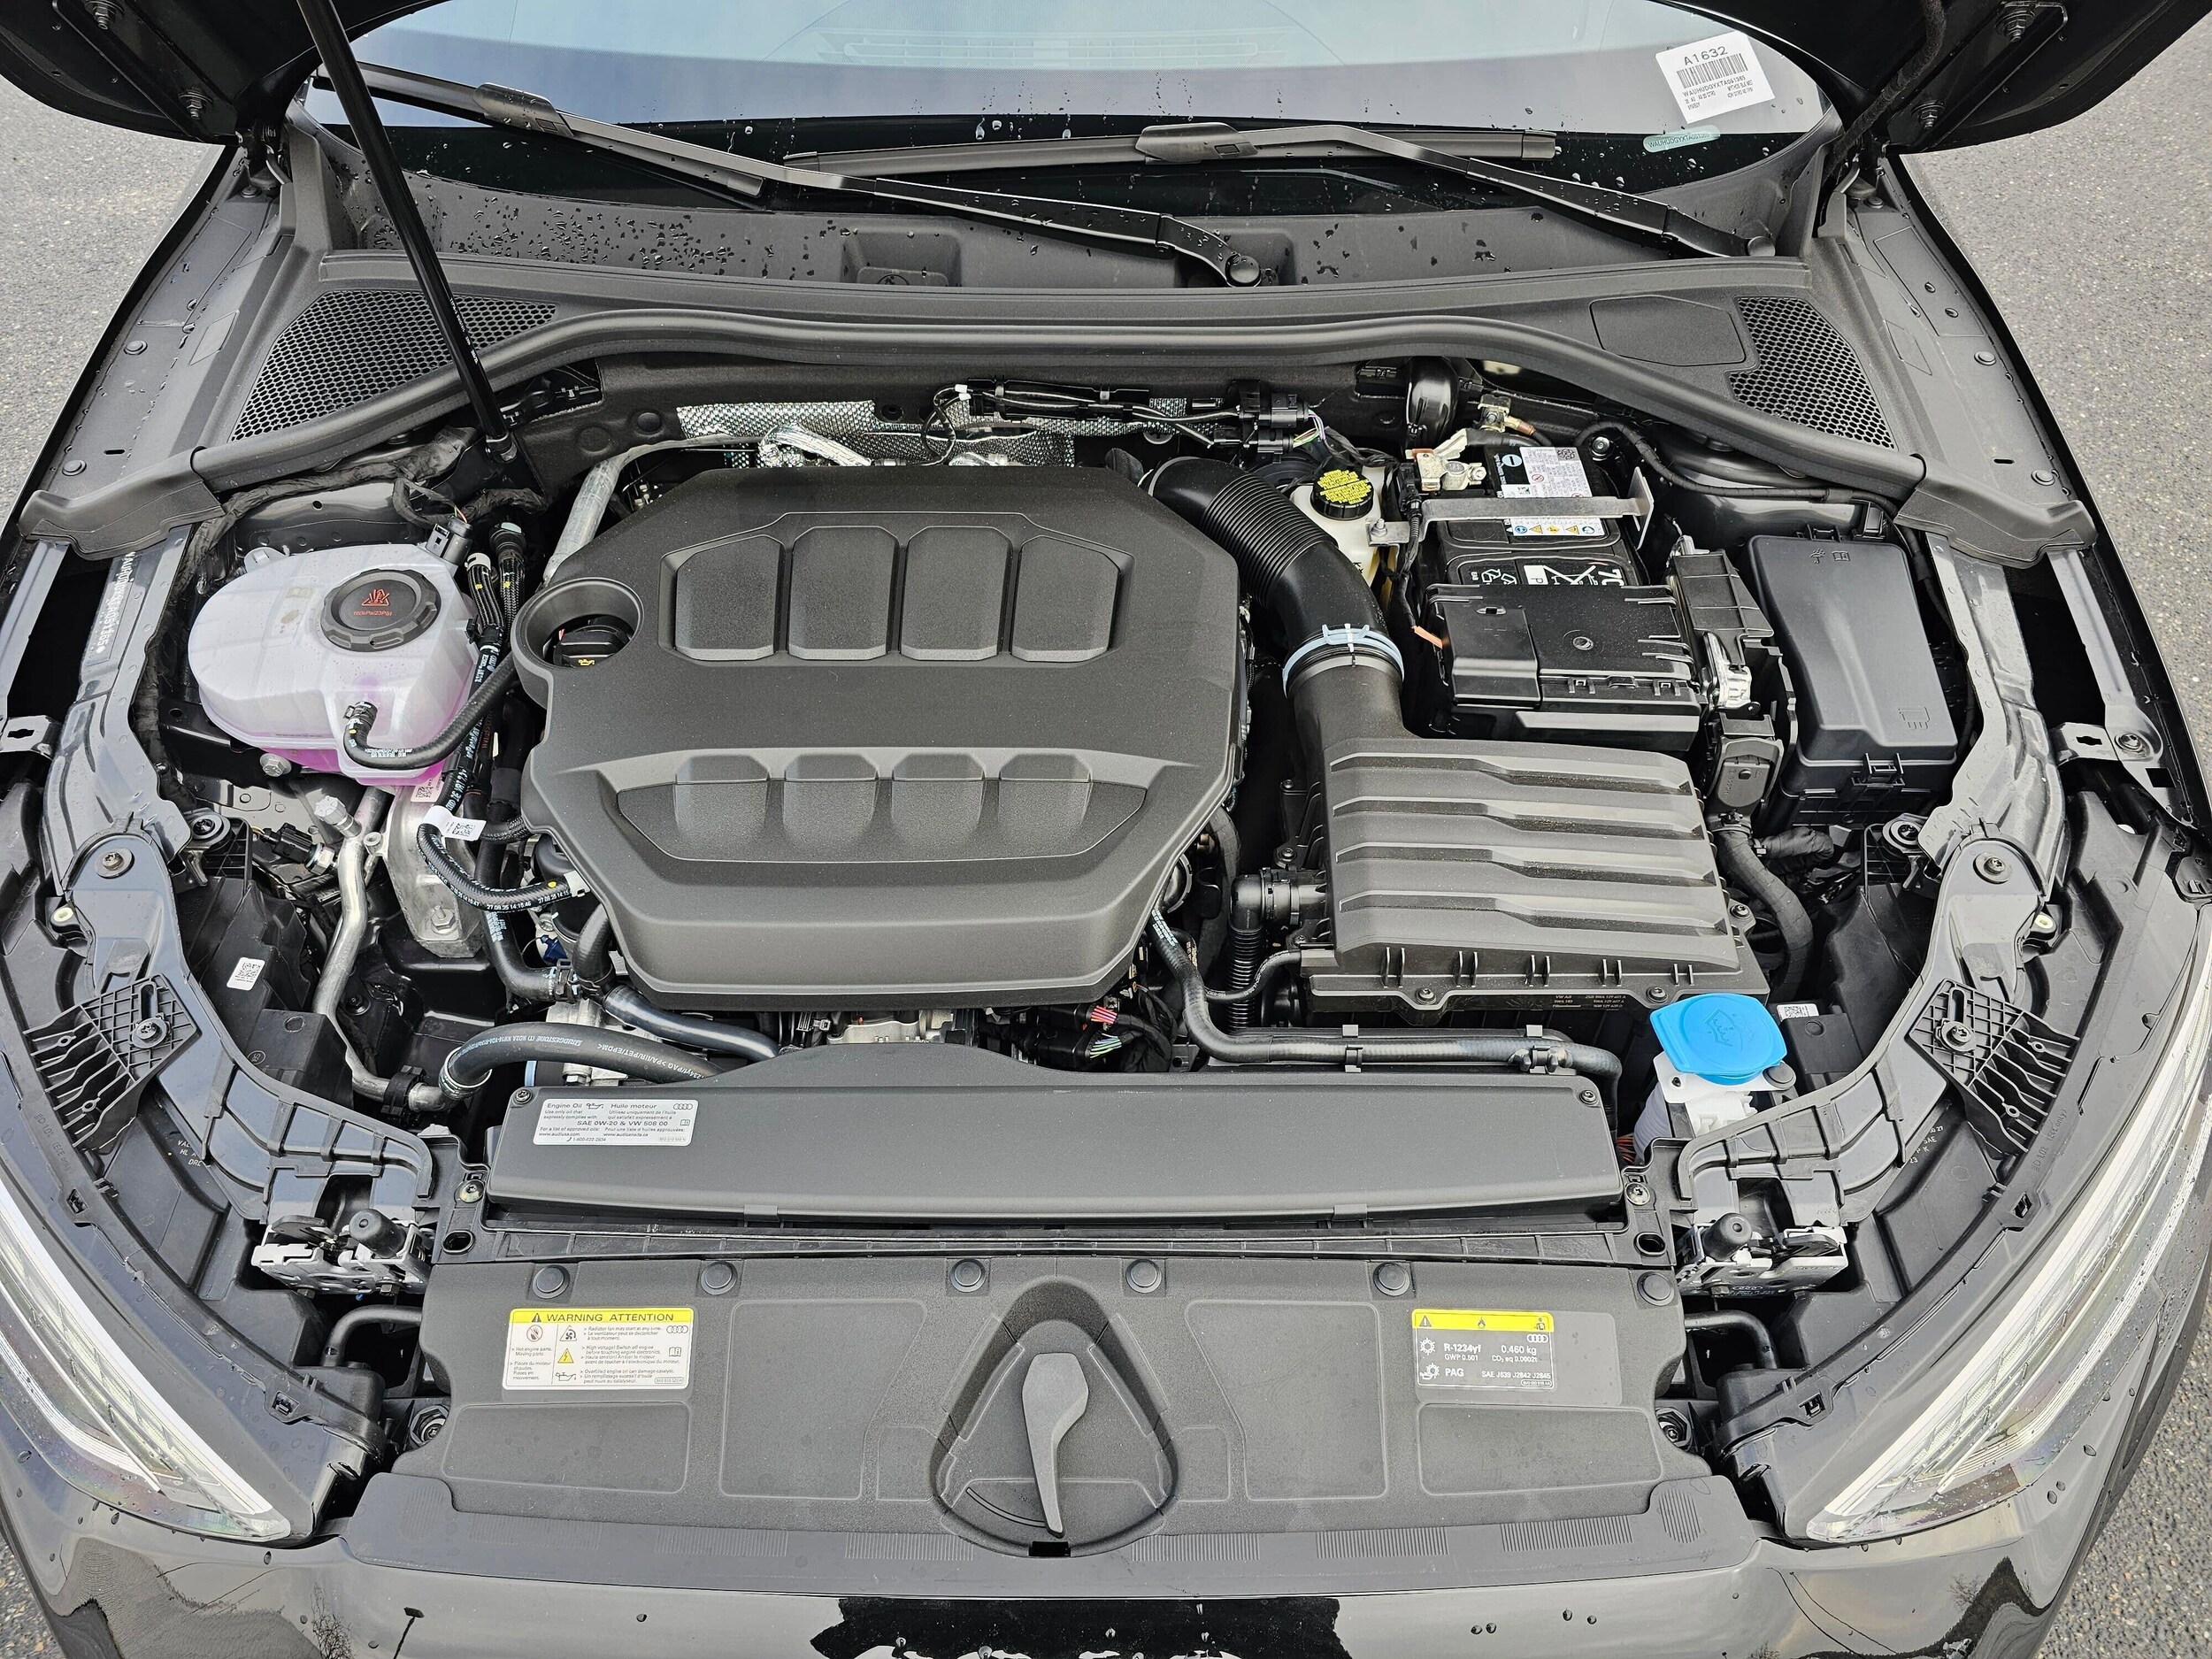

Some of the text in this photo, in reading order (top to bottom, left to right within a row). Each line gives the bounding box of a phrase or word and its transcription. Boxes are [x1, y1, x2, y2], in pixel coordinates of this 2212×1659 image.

[1684, 46, 1728, 65] A1632
[536, 1035, 582, 1047] BRIDGESTONE
[667, 1063, 705, 1079] 234yf/PAG
[1444, 1343, 1481, 1354] R-1234yf
[1501, 1345, 1537, 1356] 0.460 kg
[1445, 1368, 1464, 1377] PAG
